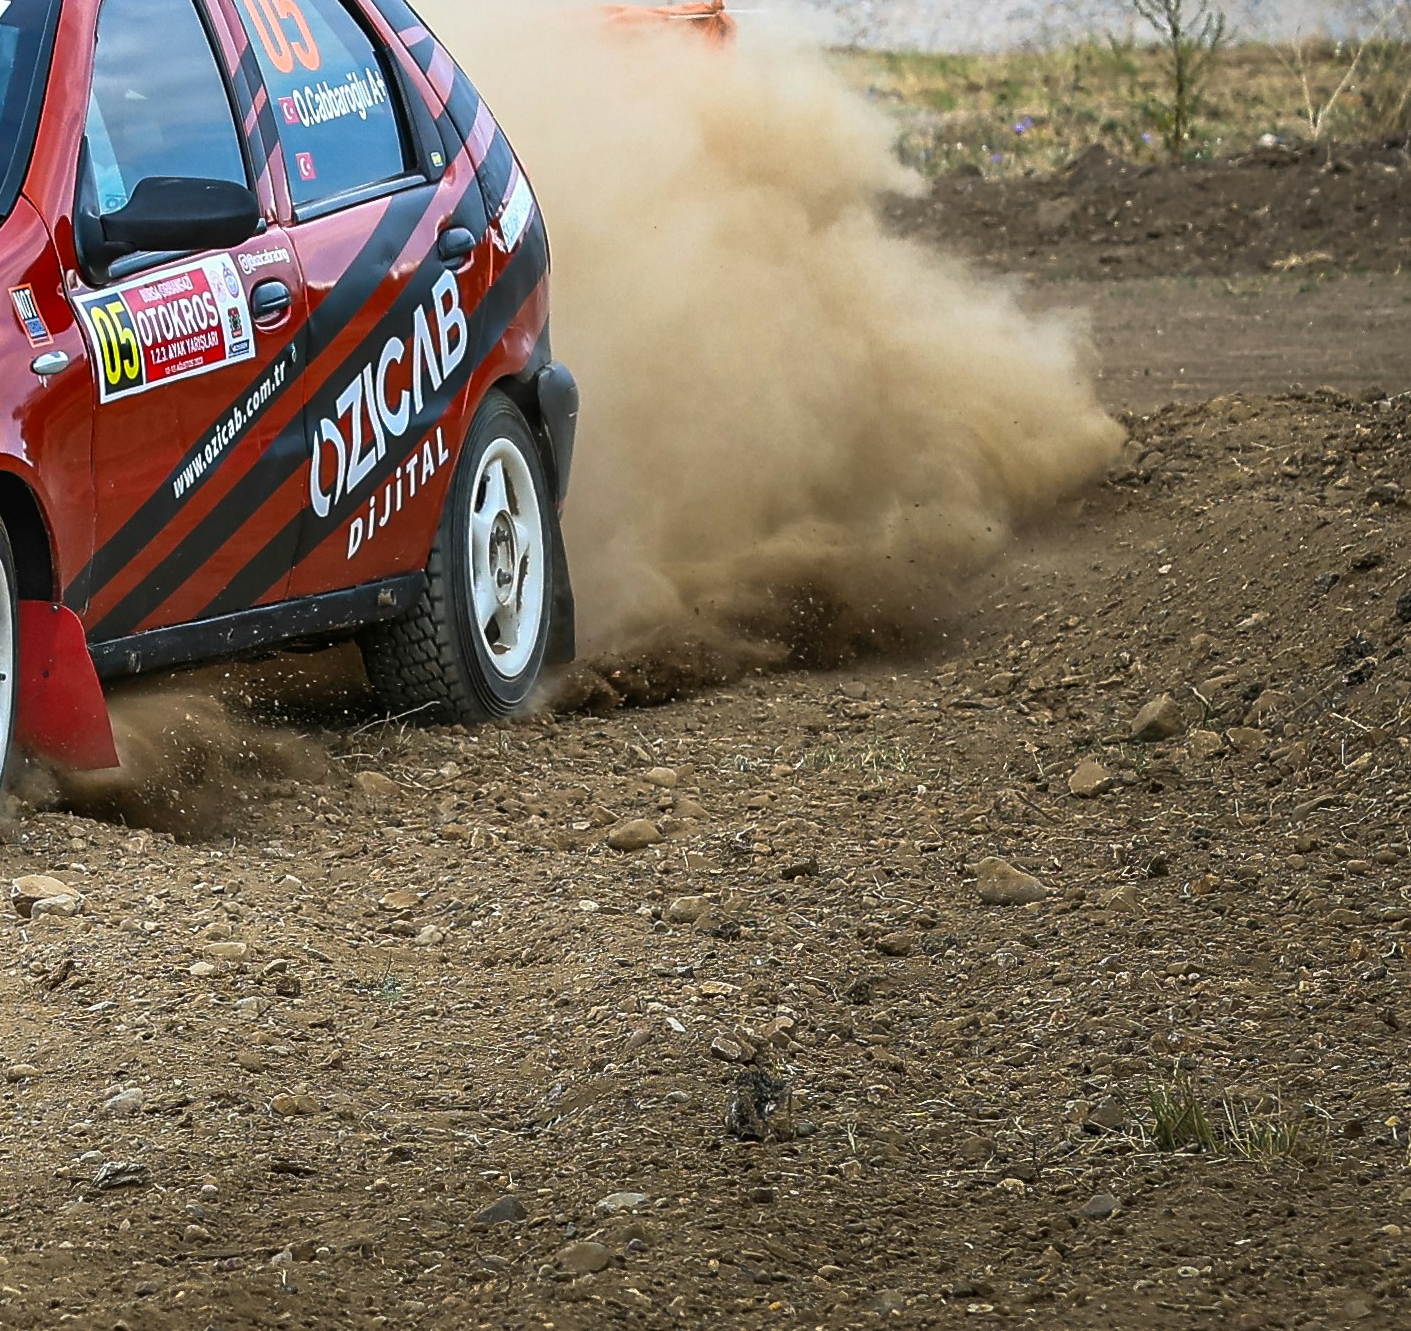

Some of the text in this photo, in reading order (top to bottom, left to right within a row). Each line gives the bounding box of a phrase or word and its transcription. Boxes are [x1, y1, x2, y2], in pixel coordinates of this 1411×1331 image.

[292, 70, 372, 128] O.Cabbaroğlu
[90, 301, 140, 385] 05
[136, 291, 219, 347] OTOKROS
[173, 360, 287, 499] www.ozicab.com.tr
[309, 269, 469, 519] OZICAB
